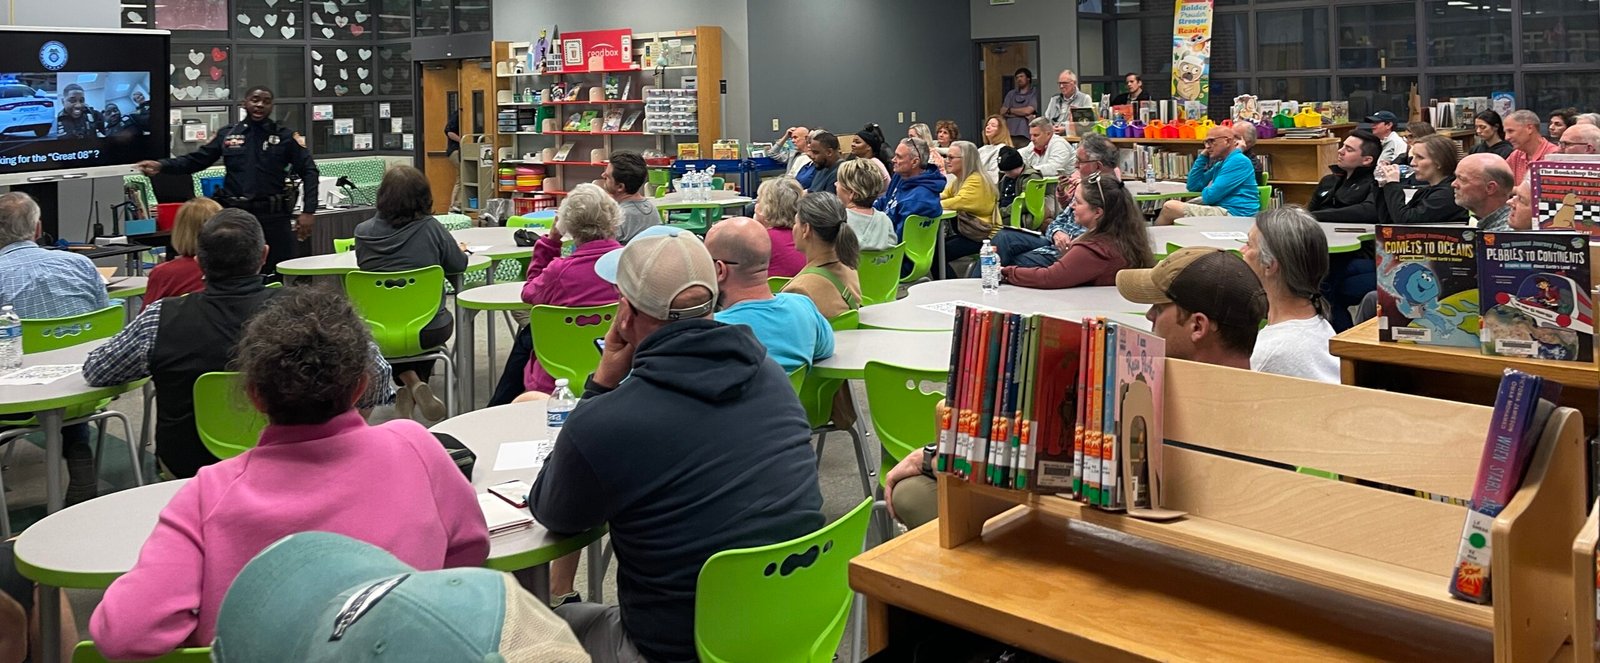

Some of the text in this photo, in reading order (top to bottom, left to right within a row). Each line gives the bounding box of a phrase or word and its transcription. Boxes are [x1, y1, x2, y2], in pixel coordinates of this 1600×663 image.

[18, 154, 31, 163] for
[32, 153, 47, 162] the
[1553, 169, 1587, 177] Bookshop
[1384, 240, 1474, 259] COMETS TO OCEANS
[1486, 248, 1585, 264] PEBBLES TO CONTINENTS
[1492, 435, 1512, 463] WHEN
[1485, 465, 1504, 495] STARS
